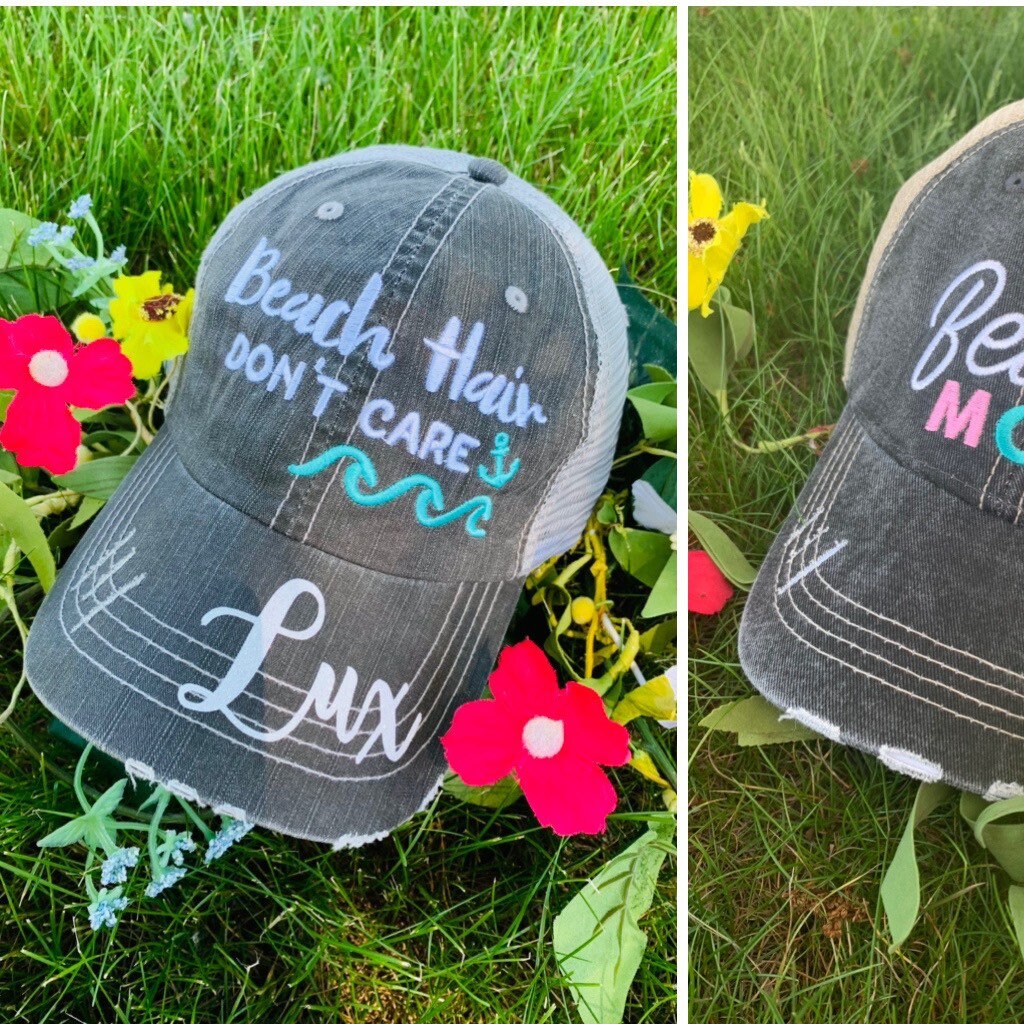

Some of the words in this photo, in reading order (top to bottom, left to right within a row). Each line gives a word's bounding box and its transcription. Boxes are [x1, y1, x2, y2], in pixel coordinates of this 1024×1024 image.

[225, 237, 395, 370] Beach
[423, 316, 546, 428] Hair
[225, 334, 348, 417] DON'T
[360, 399, 481, 474] CARE
[178, 578, 422, 764] Lux
